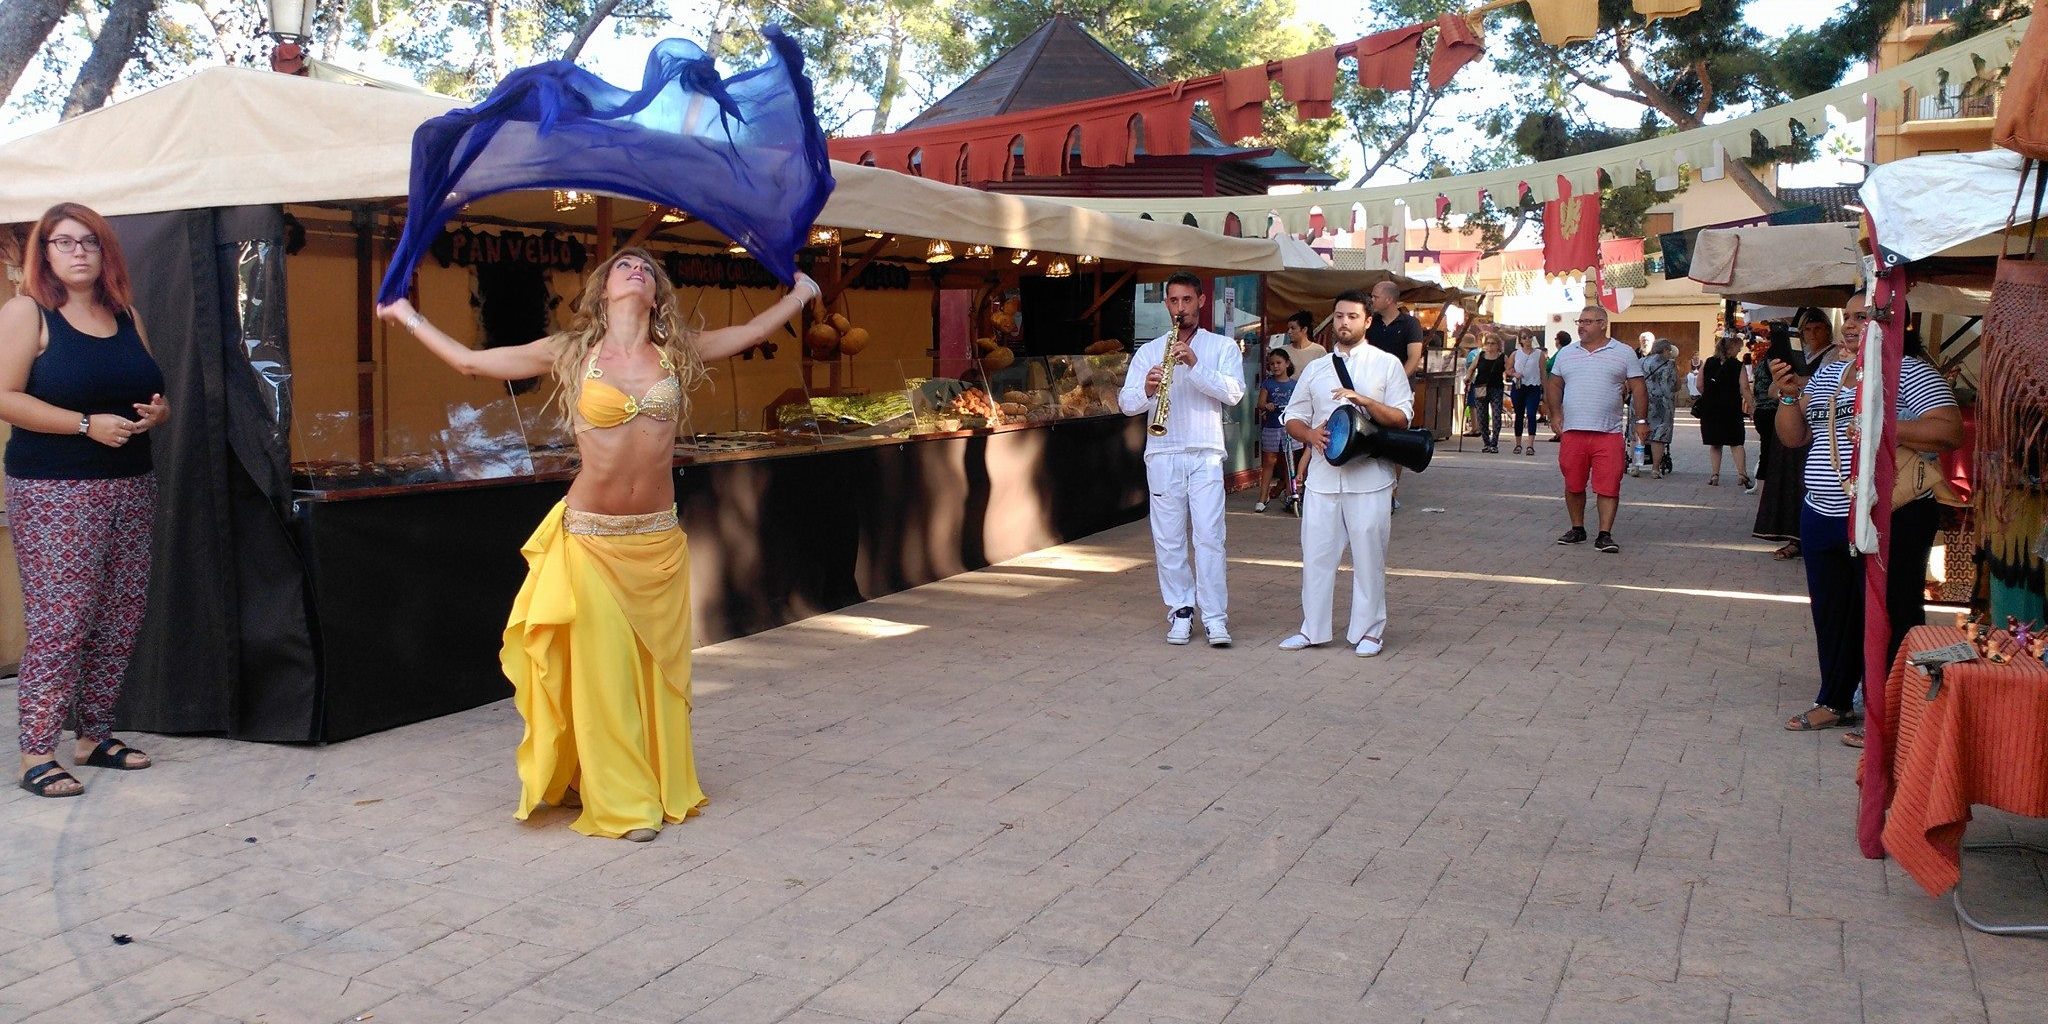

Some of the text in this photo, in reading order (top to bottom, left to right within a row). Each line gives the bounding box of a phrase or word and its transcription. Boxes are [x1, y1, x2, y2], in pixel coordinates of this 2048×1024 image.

[452, 233, 572, 265] PAN VELLO
[1811, 406, 1855, 419] FEEING
